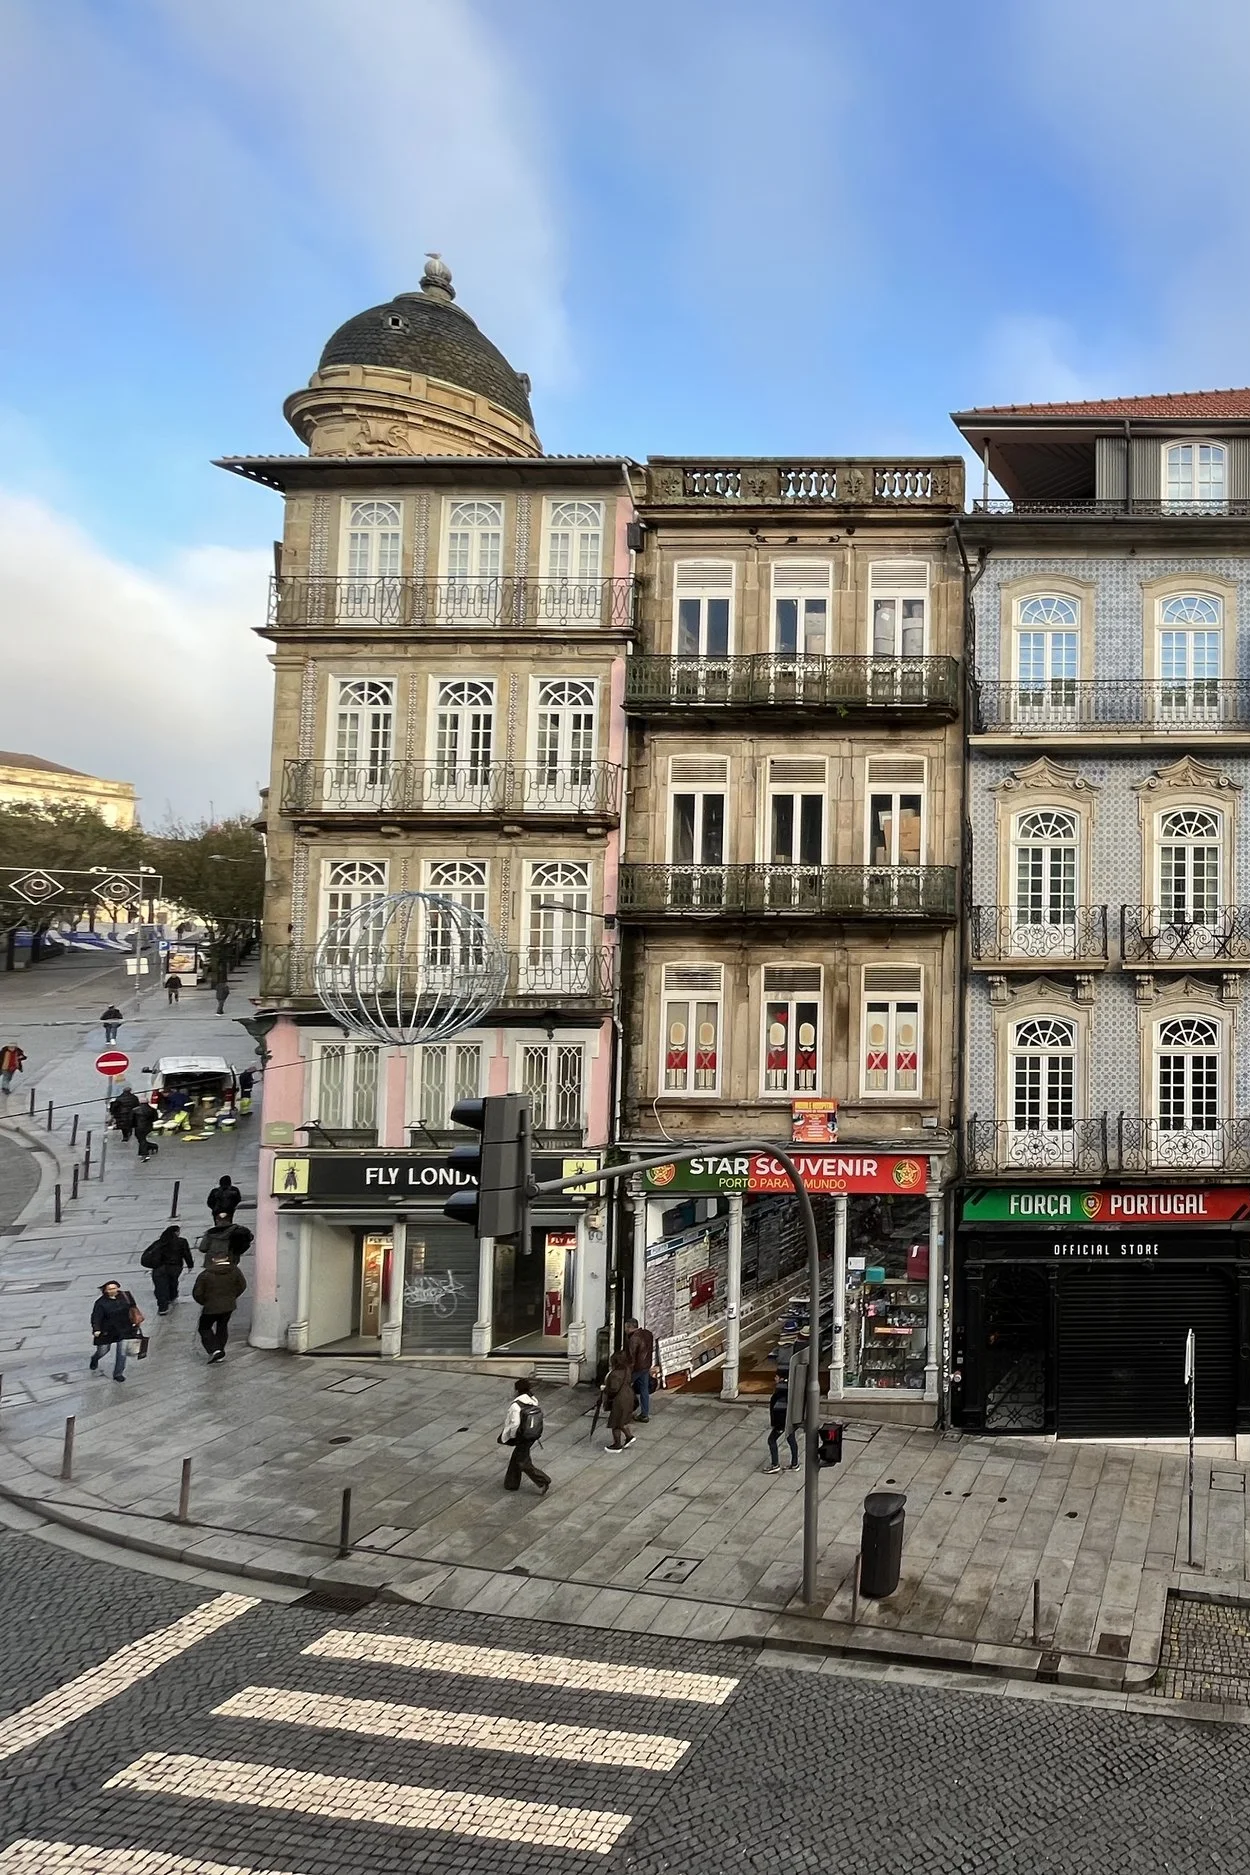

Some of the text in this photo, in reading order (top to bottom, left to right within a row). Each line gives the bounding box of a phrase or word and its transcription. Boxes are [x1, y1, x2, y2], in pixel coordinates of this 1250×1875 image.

[365, 1167, 479, 1186] FLY LOND
[689, 1157, 878, 1177] STAR SOUVENIR
[719, 1178, 757, 1188] PORTO
[760, 1179, 789, 1189] PARA
[803, 1180, 847, 1190] MUNDO
[1010, 1194, 1208, 1217] FORÇA PORTUGAL
[1053, 1244, 1160, 1256] OFFICIAL STORE
